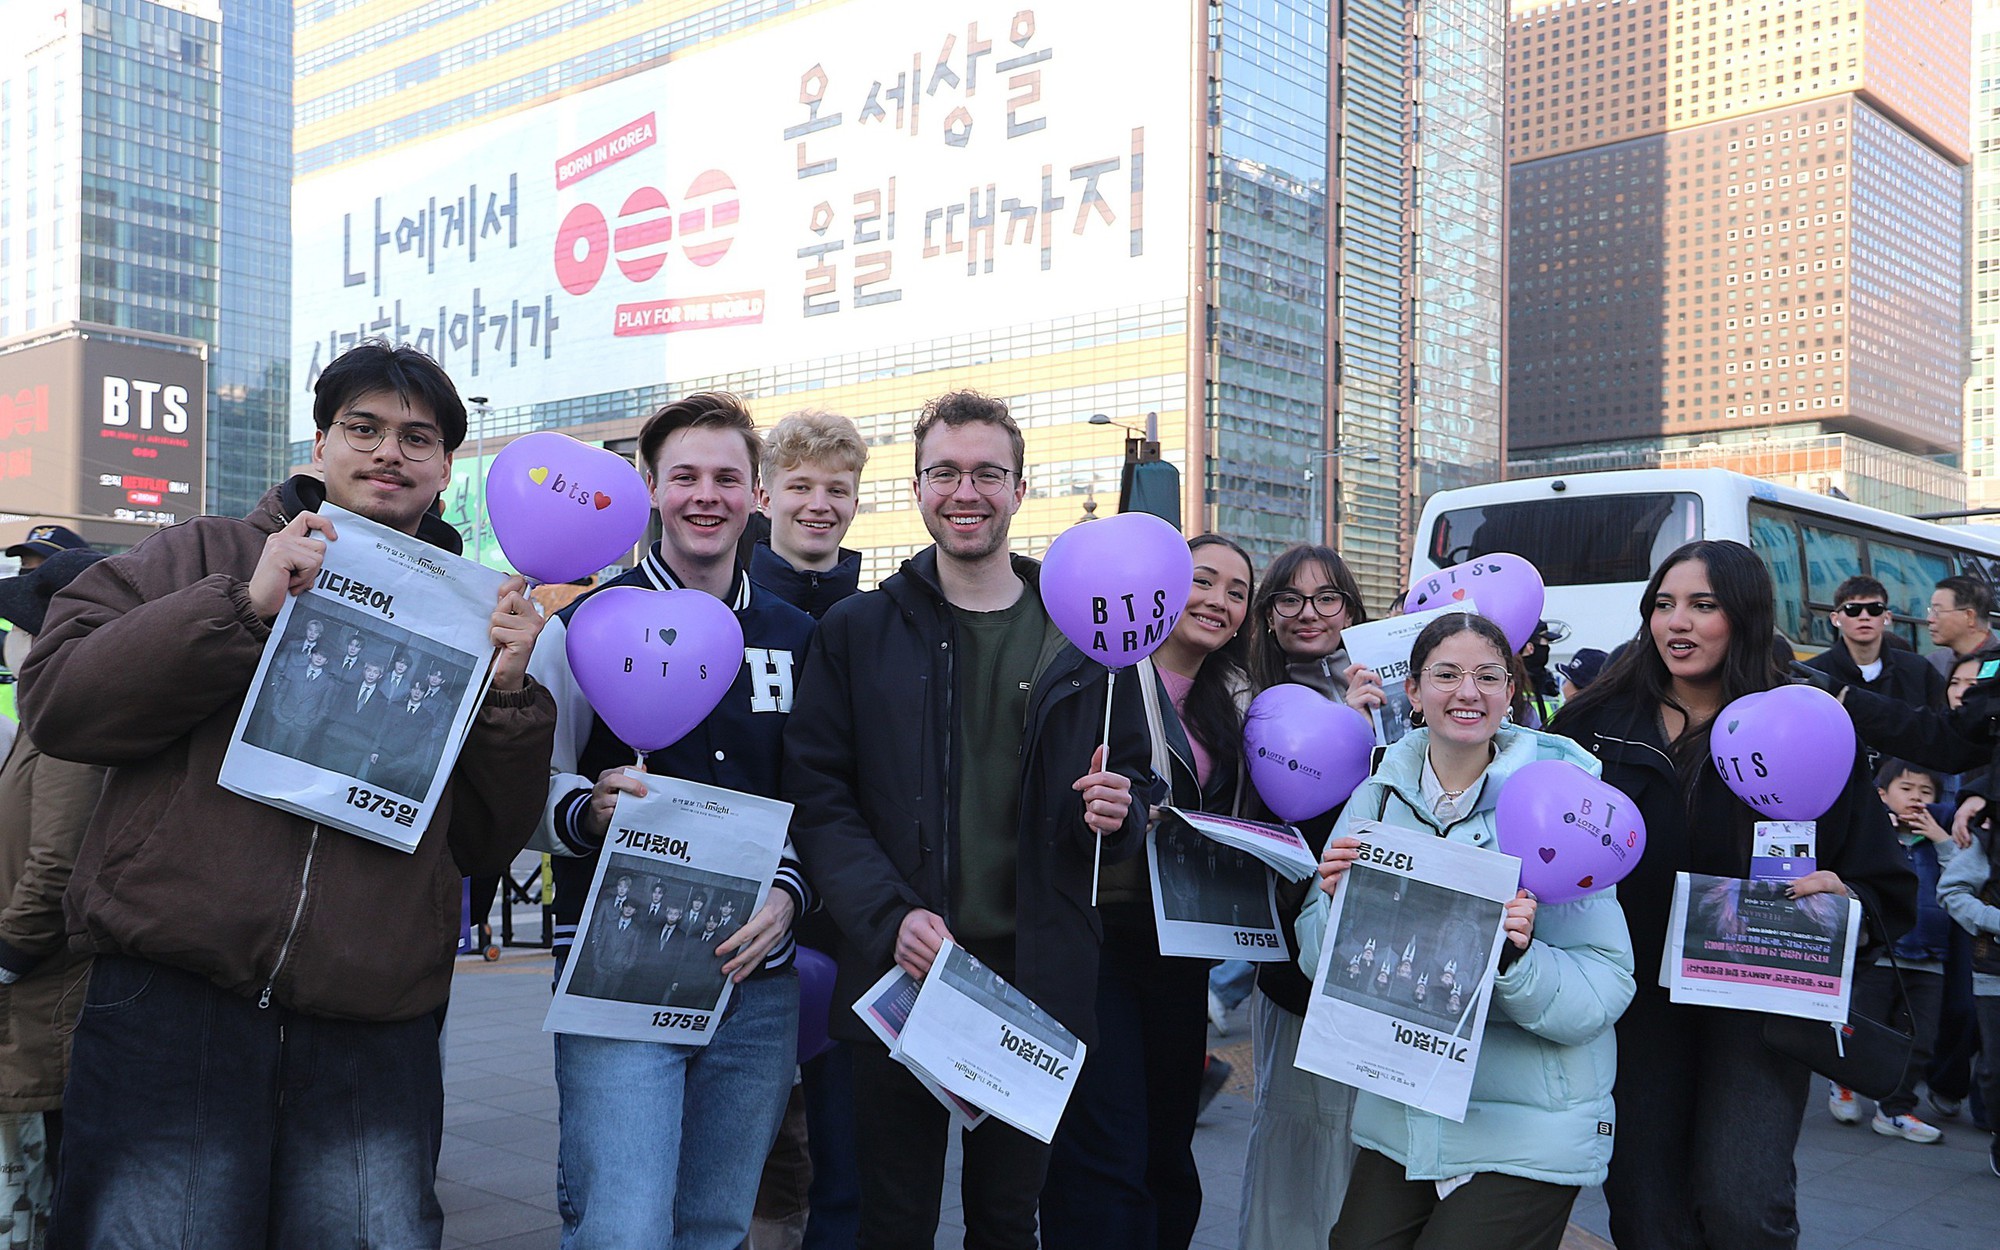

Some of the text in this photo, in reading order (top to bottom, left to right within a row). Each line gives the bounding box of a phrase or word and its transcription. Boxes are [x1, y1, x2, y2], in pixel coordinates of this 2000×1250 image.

[784, 9, 1053, 181] 온 세상을
[558, 124, 654, 183] BORN IN KOREA
[343, 172, 518, 298] 나에게서
[797, 126, 1145, 319] 울릴 때까지
[618, 297, 764, 328] PLAY FOR THE WORLD
[414, 287, 560, 377] 이야기가
[102, 375, 189, 434] BTS
[551, 473, 590, 505] bts
[417, 556, 447, 578] Insight
[1428, 562, 1484, 595] BTS
[1092, 589, 1166, 625] BTS
[1092, 610, 1179, 652] ARMY
[744, 647, 795, 714] H
[1267, 750, 1287, 761] LOTTE
[1299, 764, 1322, 777] LOTTE
[1717, 751, 1768, 782] BTS
[346, 785, 420, 828] 1375일
[704, 800, 731, 815] Insight
[1577, 818, 1602, 835] LOTTE
[615, 828, 692, 863] 기다렸어,
[1611, 841, 1626, 859] LOTTE
[1233, 931, 1280, 948] 1375일
[651, 1011, 710, 1032] 1375일
[1000, 1024, 1069, 1081] 기다렸어,
[1391, 1020, 1468, 1064] 기다렸어,
